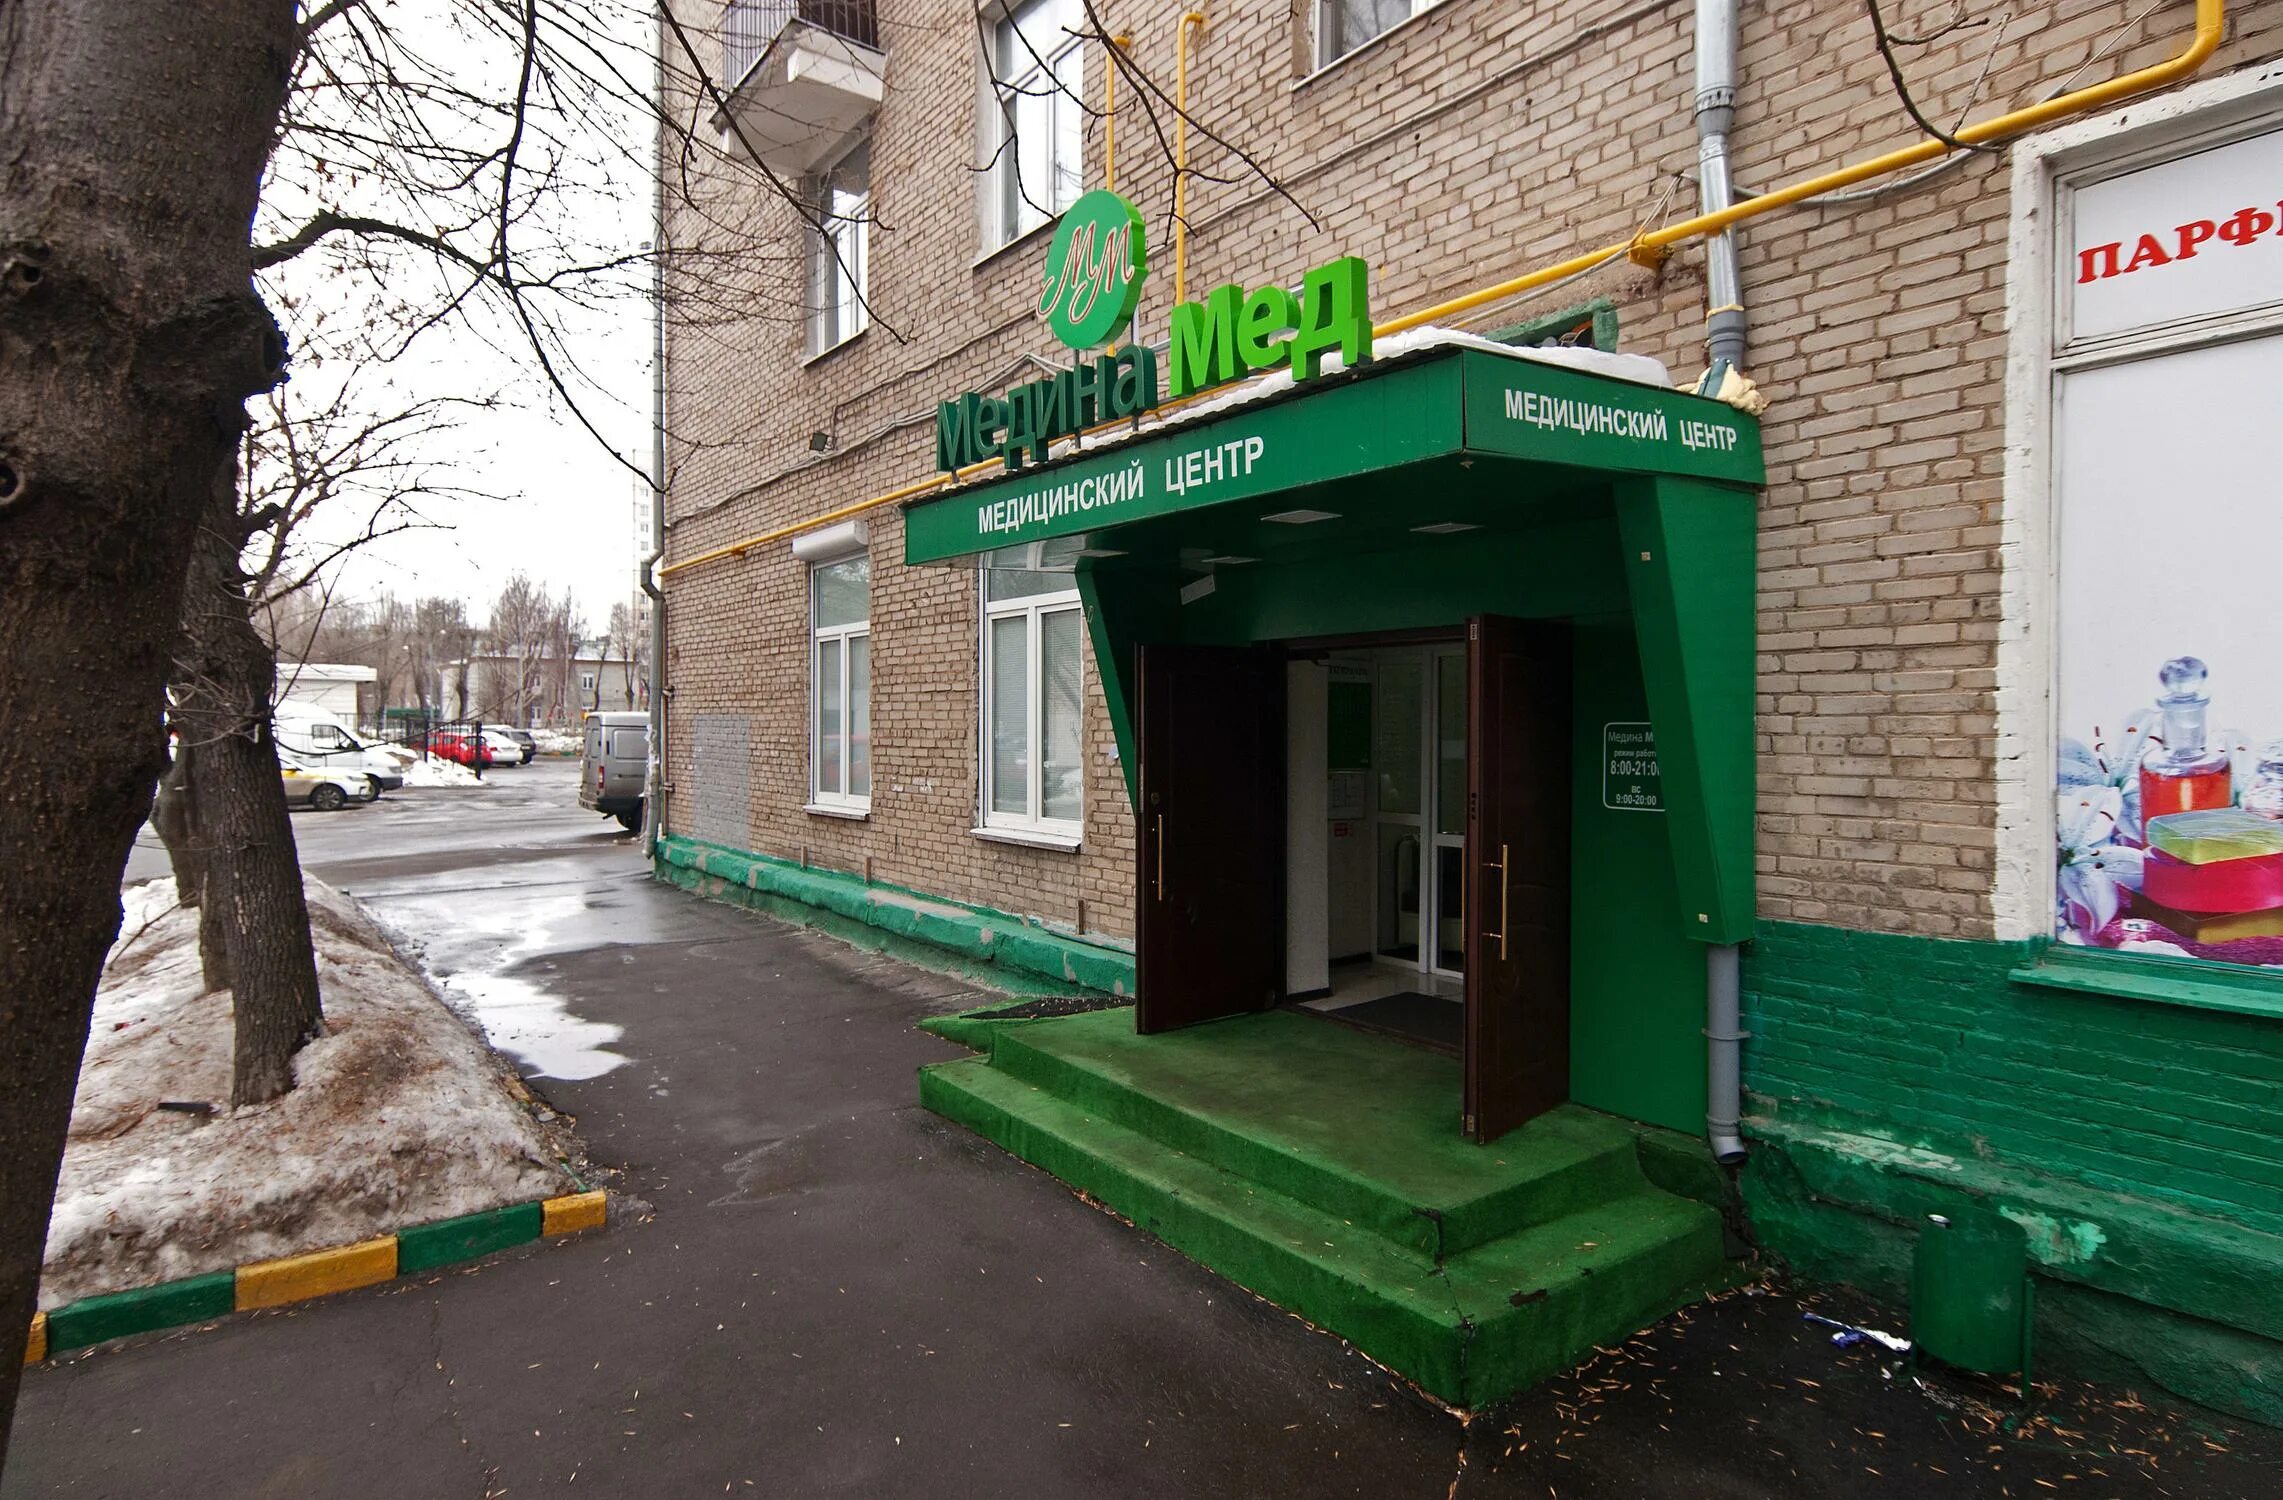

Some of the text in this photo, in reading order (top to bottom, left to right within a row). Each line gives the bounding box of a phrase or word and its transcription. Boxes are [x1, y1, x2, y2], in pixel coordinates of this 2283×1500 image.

[2077, 200, 2283, 284] ПАРФ
[936, 344, 1158, 472] Медина
[1504, 388, 1737, 451] МЕДИЦИНСКИЙ ЦЕНТР
[978, 436, 1265, 534] МЕДИЦИНСКИЙ ЦЕНТР
[1608, 731, 1643, 744] Медина
[1616, 794, 1657, 806] 9:00-20:00
